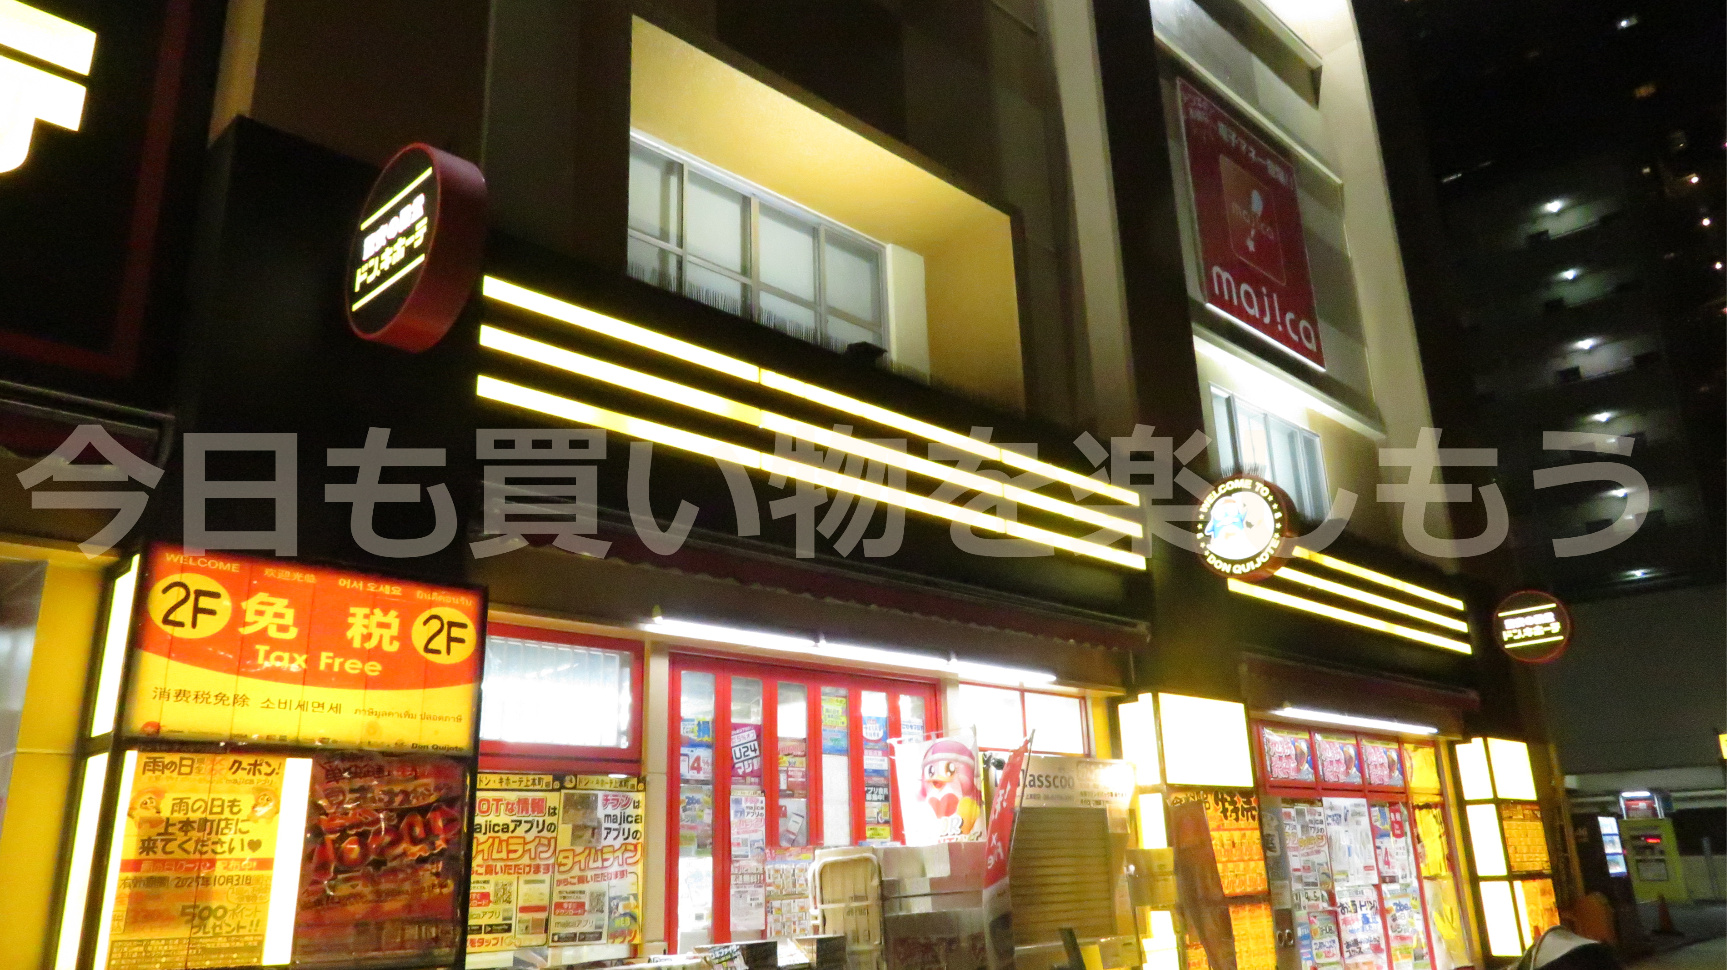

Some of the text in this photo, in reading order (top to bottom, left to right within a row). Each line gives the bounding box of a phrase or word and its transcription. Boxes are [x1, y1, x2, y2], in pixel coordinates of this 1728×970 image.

[1199, 479, 1270, 513] WELCOME TO
[165, 552, 240, 572] WELCOME
[1206, 538, 1281, 574] DON QUIJOTE
[161, 580, 222, 629] 2F
[422, 614, 468, 656] 2F
[254, 644, 382, 676] Tax Free
[733, 742, 758, 761] U24
[142, 756, 195, 776] 雨の日
[170, 796, 242, 816] 雨の日も
[156, 816, 251, 837] 上本町店に
[603, 813, 643, 825] majica
